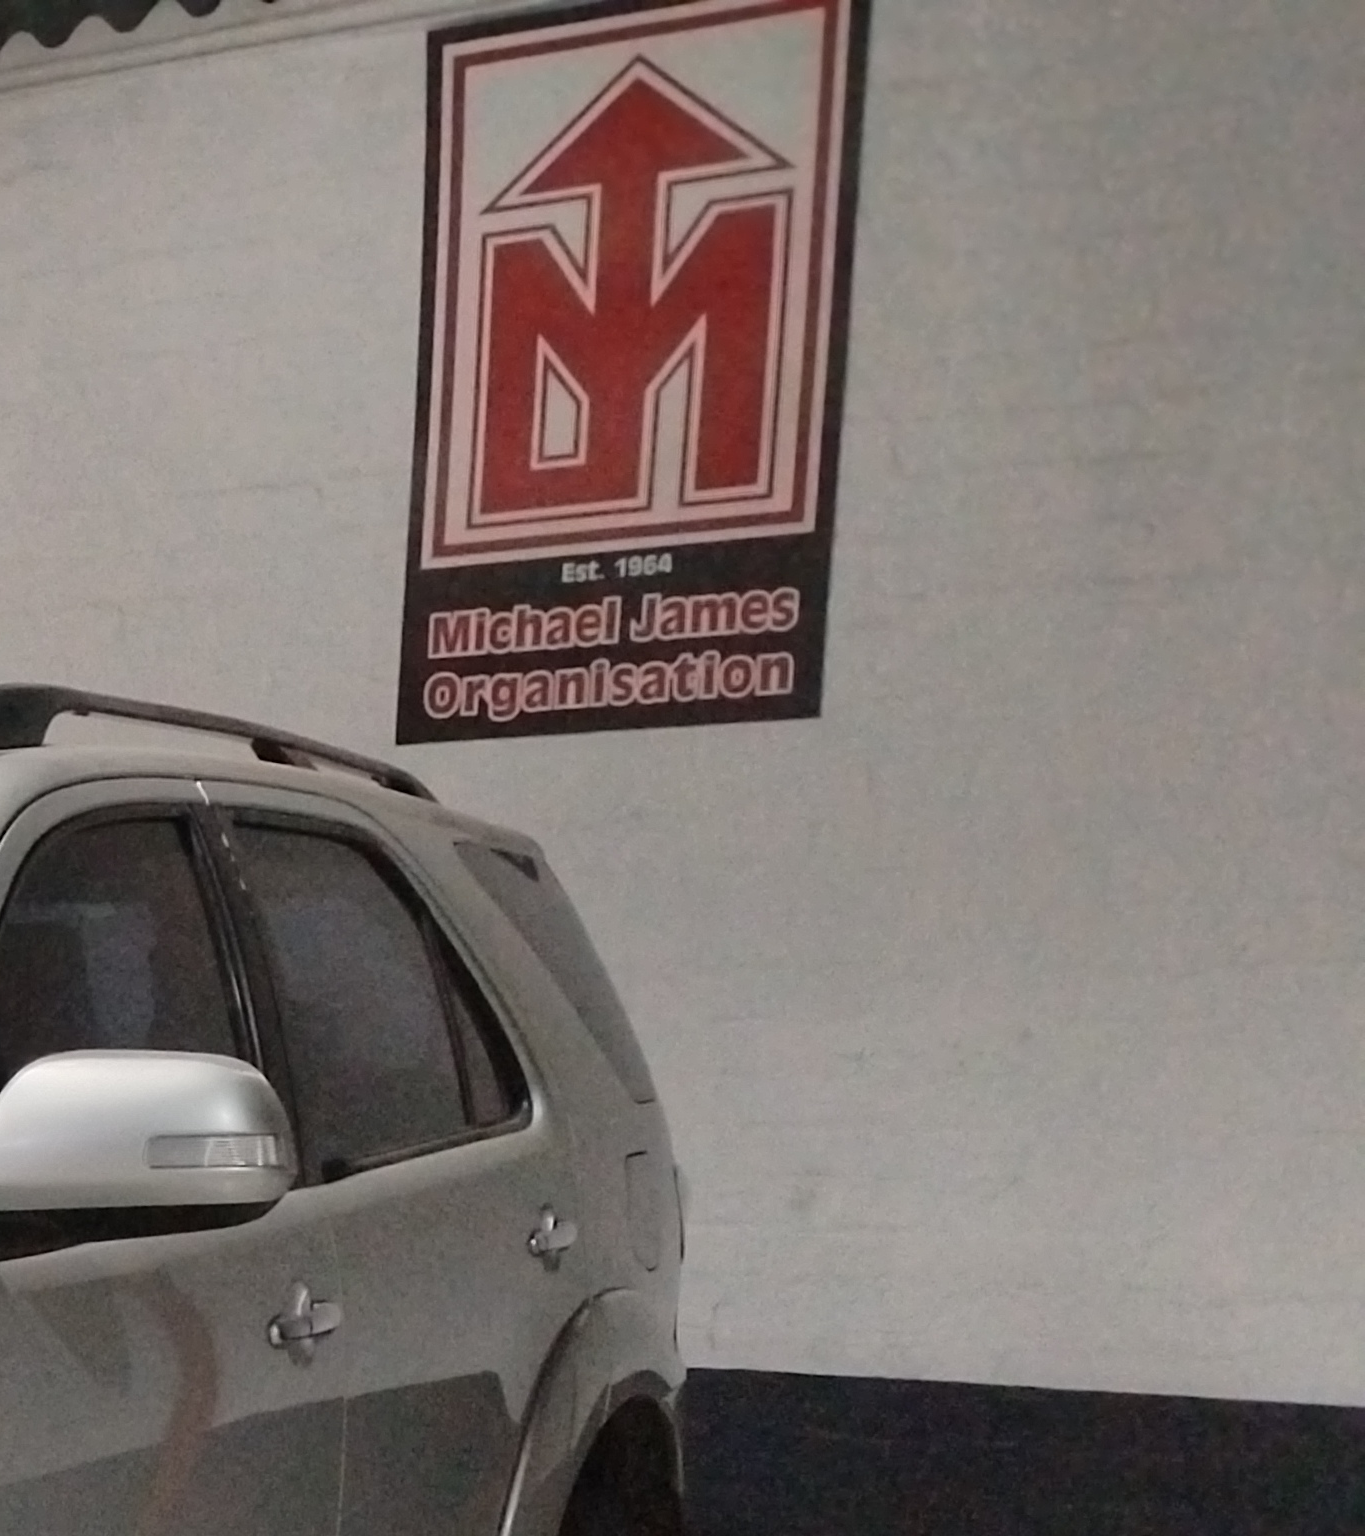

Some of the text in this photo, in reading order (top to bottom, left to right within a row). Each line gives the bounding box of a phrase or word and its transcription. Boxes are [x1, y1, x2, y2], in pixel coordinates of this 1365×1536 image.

[560, 553, 673, 584] Est. 1964
[427, 586, 801, 659] Michael James
[422, 651, 795, 723] Organisation
